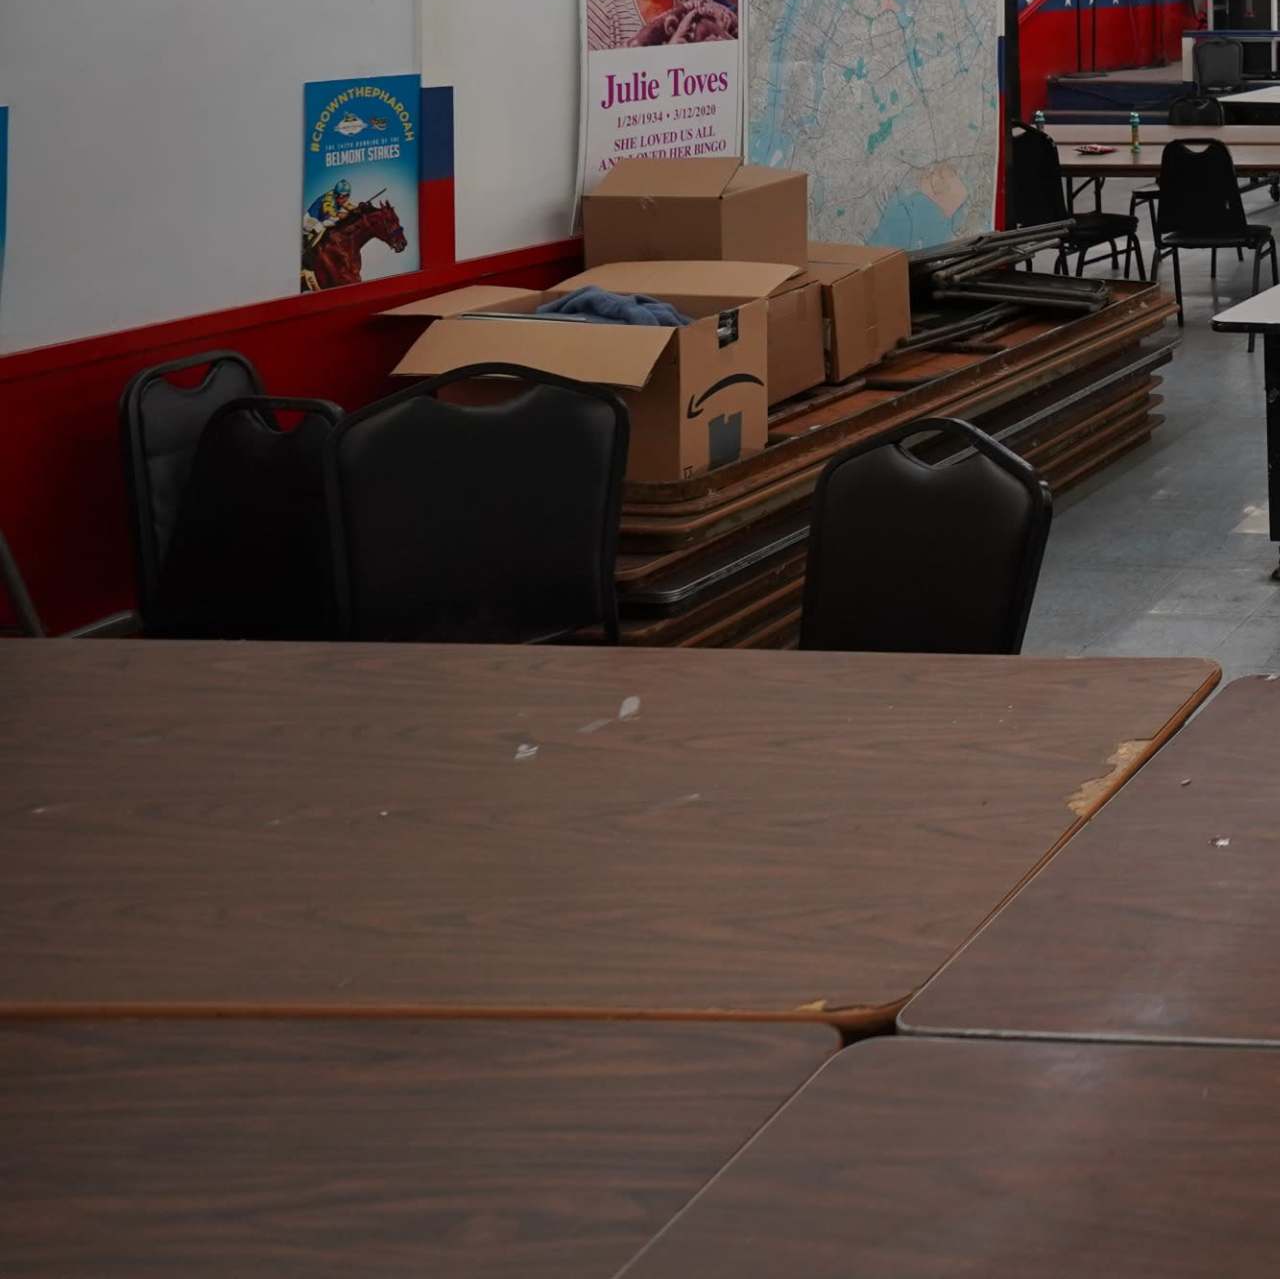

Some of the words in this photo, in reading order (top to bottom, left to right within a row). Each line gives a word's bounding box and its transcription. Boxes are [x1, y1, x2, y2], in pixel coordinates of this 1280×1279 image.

[601, 71, 660, 109] Julie
[667, 67, 728, 97] Toves
[673, 104, 716, 121] 3/12/2020
[614, 137, 637, 152] SHE
[640, 131, 678, 148] LOVED
[680, 128, 693, 141] US
[695, 125, 716, 139] ALL
[669, 145, 692, 159] HER
[694, 140, 726, 156] BINGO
[326, 148, 365, 167] BELMONT
[368, 145, 400, 161] STAKES
